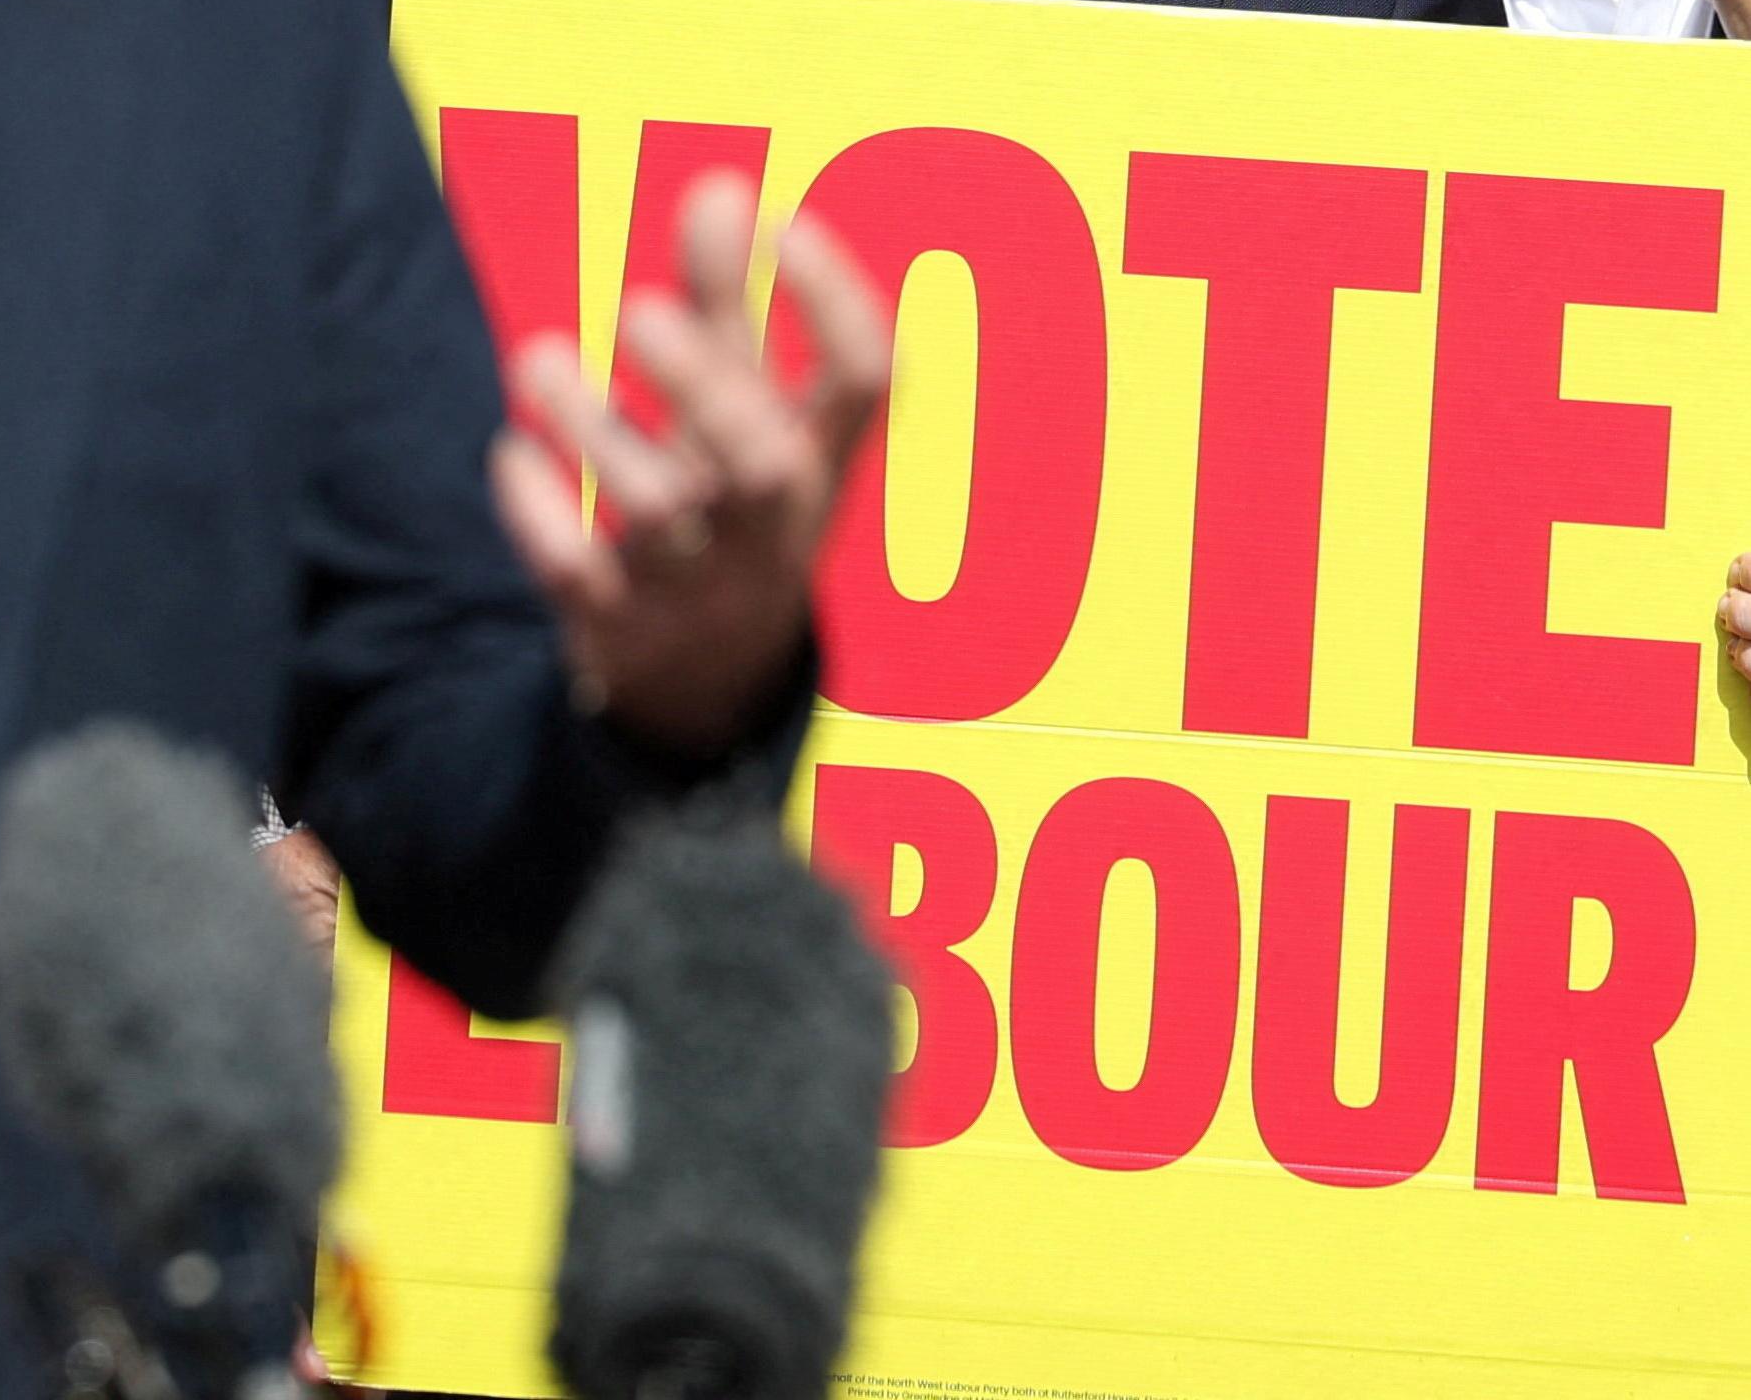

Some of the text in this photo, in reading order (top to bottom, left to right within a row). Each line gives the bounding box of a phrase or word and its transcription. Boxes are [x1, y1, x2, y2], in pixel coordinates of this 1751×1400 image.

[381, 761, 1697, 1206] LBOUR
[848, 1386, 884, 1399] Printed
[886, 1389, 900, 1400] by
[855, 1374, 865, 1384] of
[868, 1376, 884, 1385] the
[887, 1377, 914, 1388] North
[917, 1379, 942, 1390] West
[945, 1381, 980, 1393] Labour
[983, 1383, 1009, 1397] Party
[1012, 1385, 1036, 1398] both
[1038, 1388, 1049, 1398] at
[1052, 1388, 1106, 1400] Rutherford
